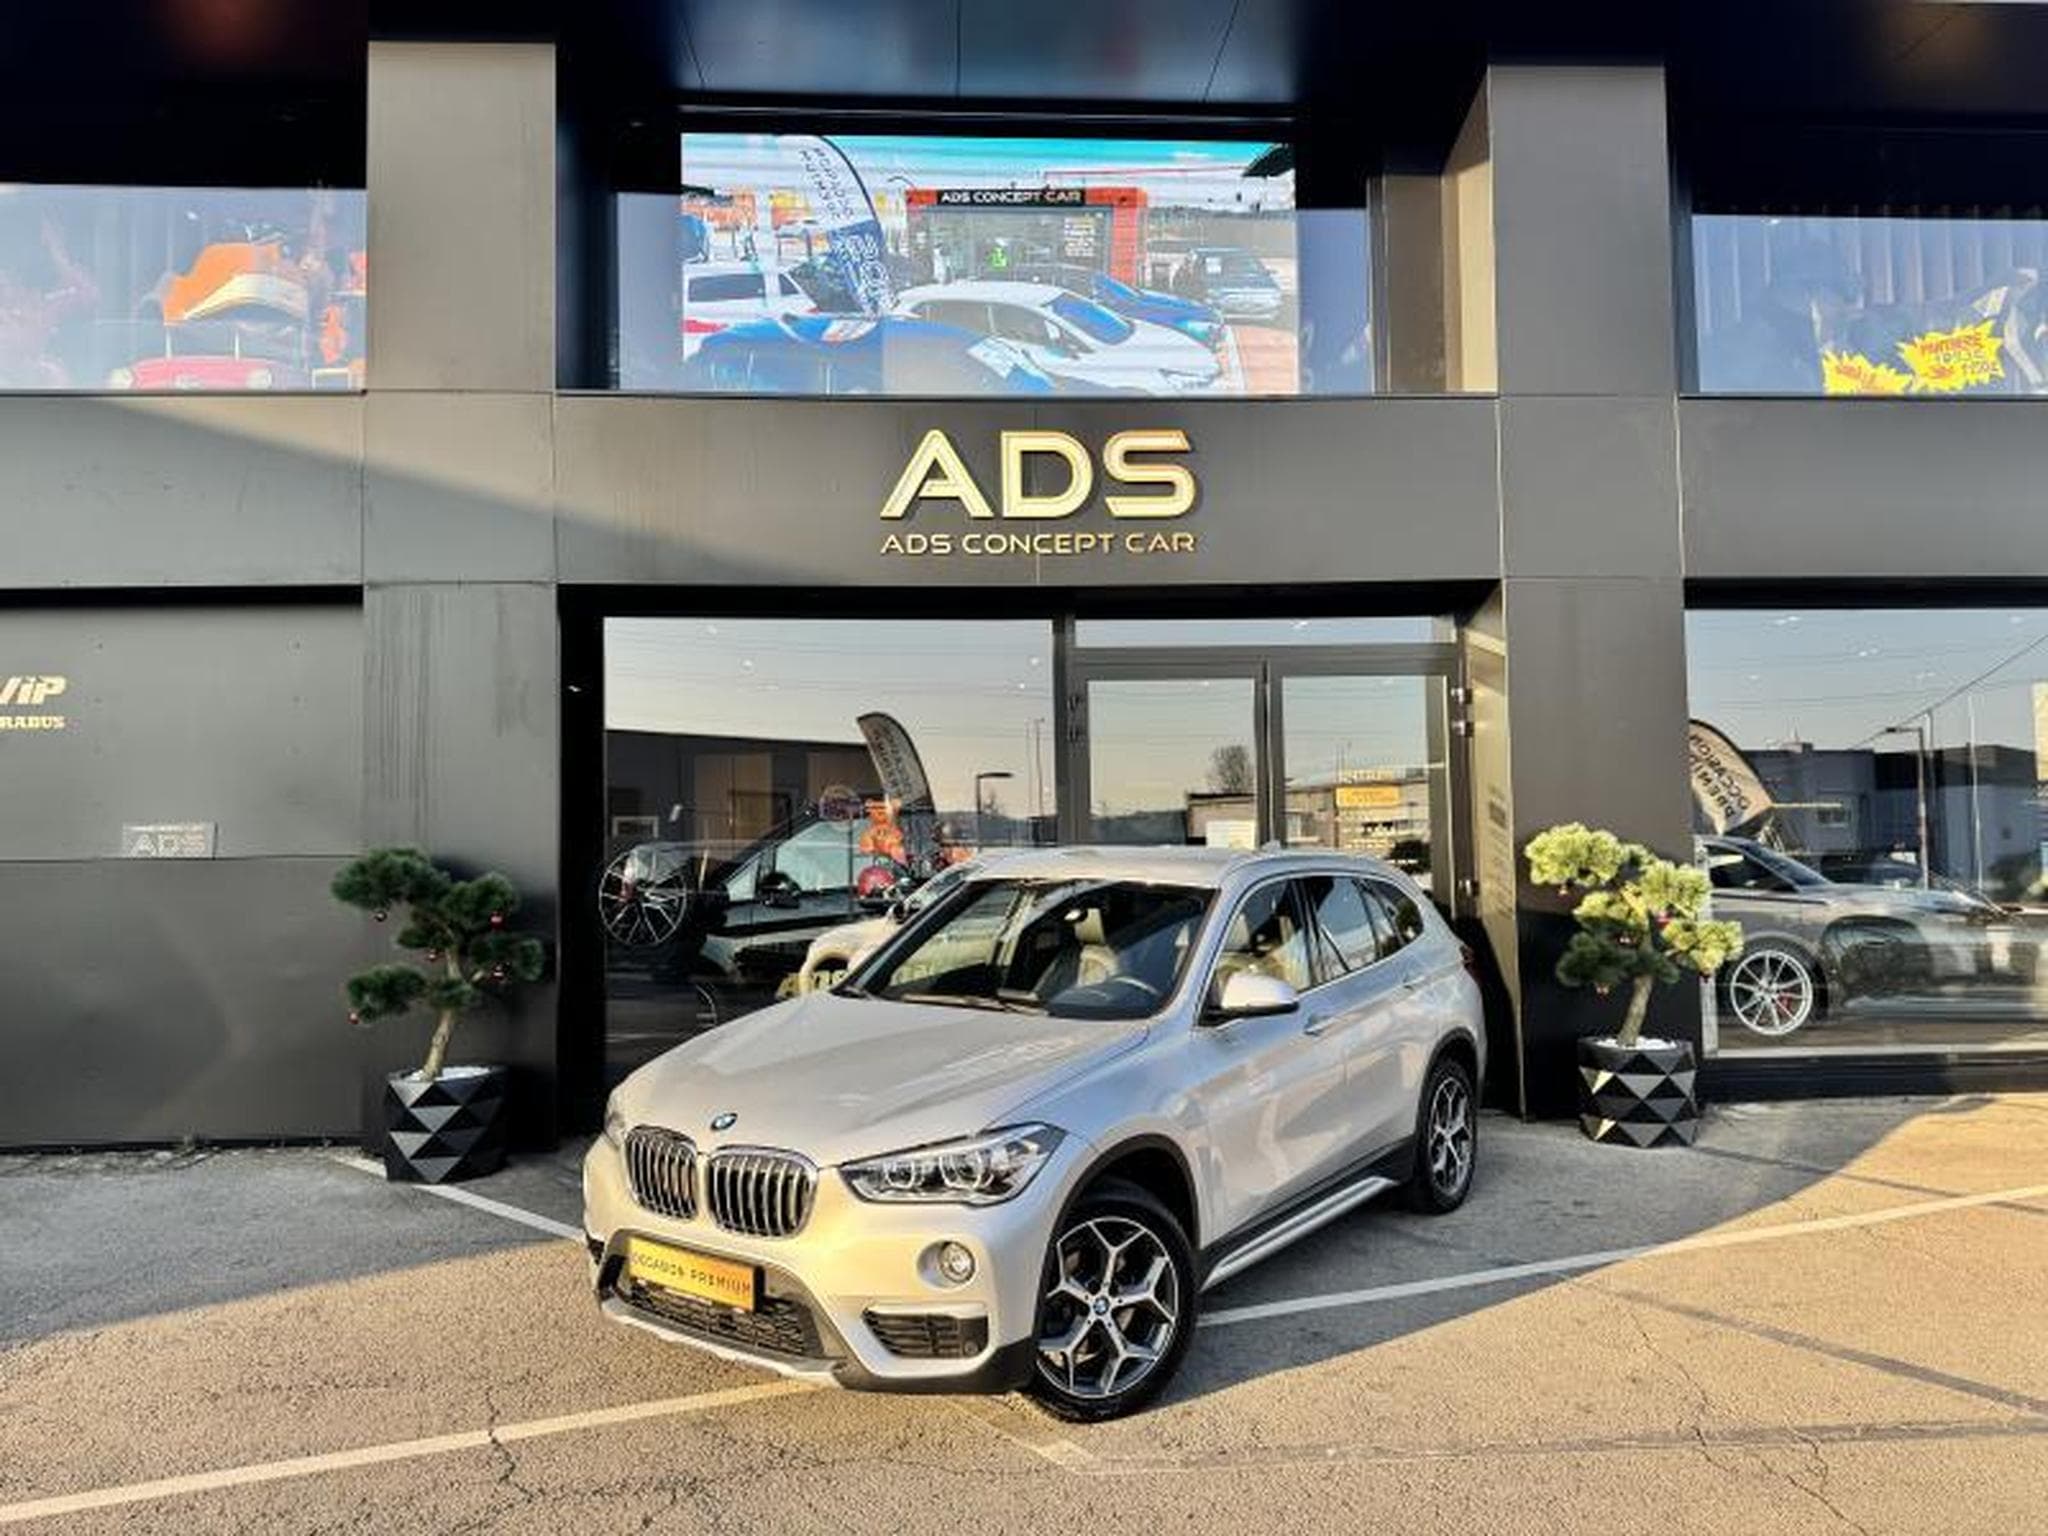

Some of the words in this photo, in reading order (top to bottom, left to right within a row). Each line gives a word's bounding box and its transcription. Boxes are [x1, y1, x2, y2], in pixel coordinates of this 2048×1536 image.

[941, 191, 970, 203] ADS
[973, 190, 1041, 203] CONCEPT
[1044, 189, 1081, 202] CAR
[880, 429, 1197, 517] ADS
[880, 534, 951, 555] ADS
[962, 533, 1114, 555] CONCEPT
[1125, 532, 1195, 553] CAR
[0, 715, 65, 729] RABUS
